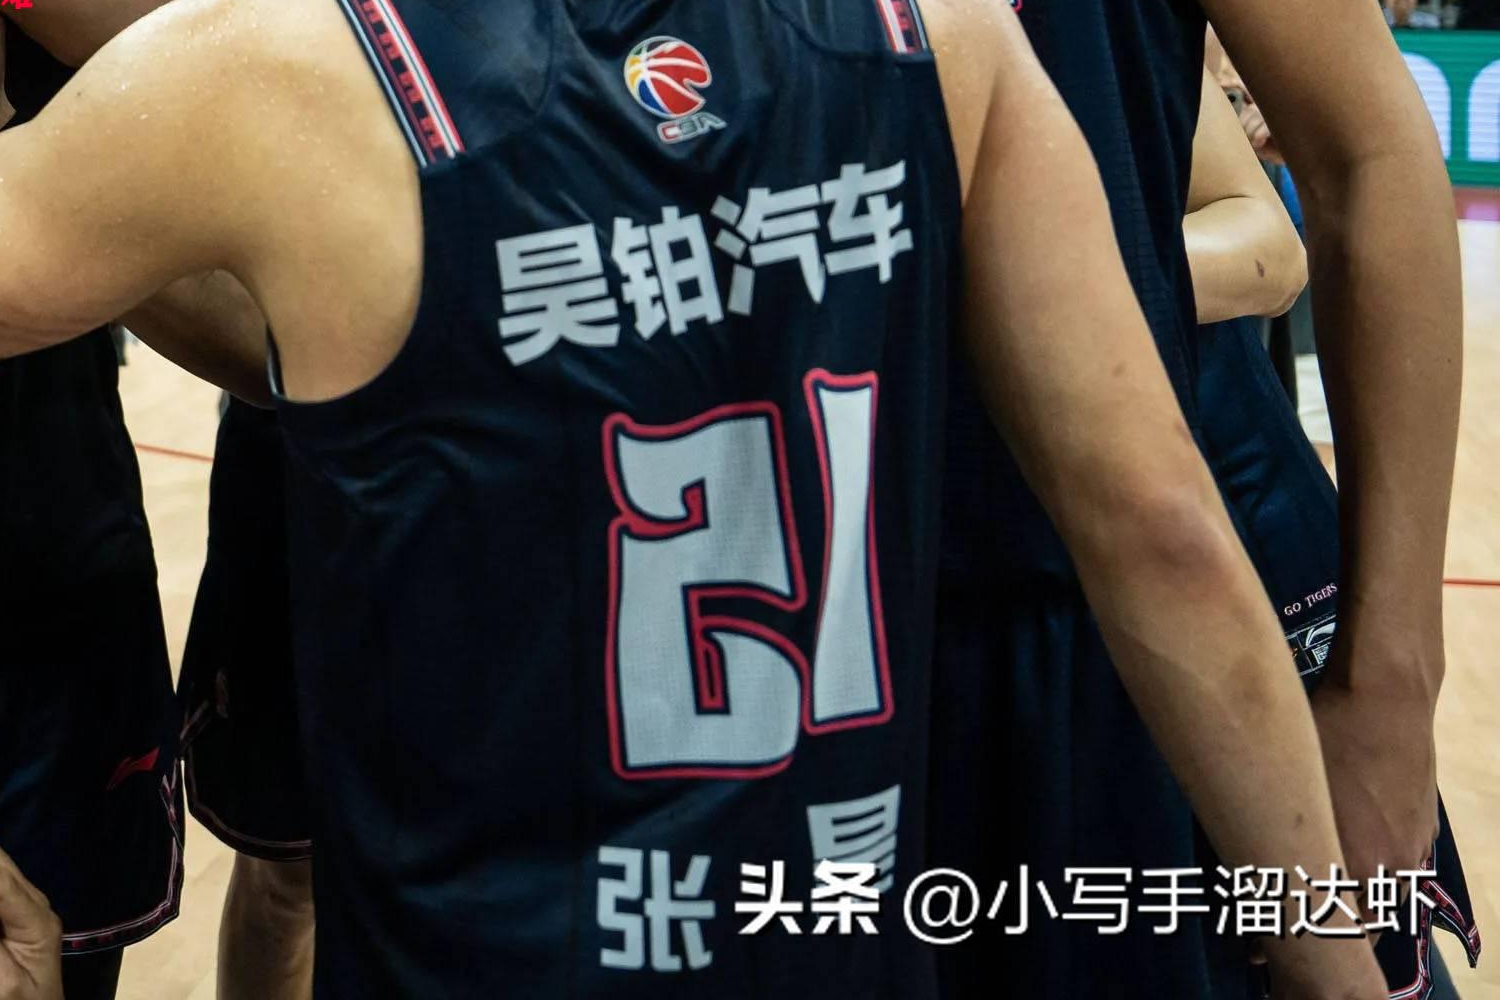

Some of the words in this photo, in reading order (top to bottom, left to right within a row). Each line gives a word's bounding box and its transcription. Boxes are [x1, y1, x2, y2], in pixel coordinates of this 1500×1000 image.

[497, 160, 914, 367] 昊铂汽车
[603, 368, 894, 779] 21
[1284, 602, 1301, 616] GO
[1304, 582, 1338, 608] TIGERS
[597, 845, 716, 972] 张
